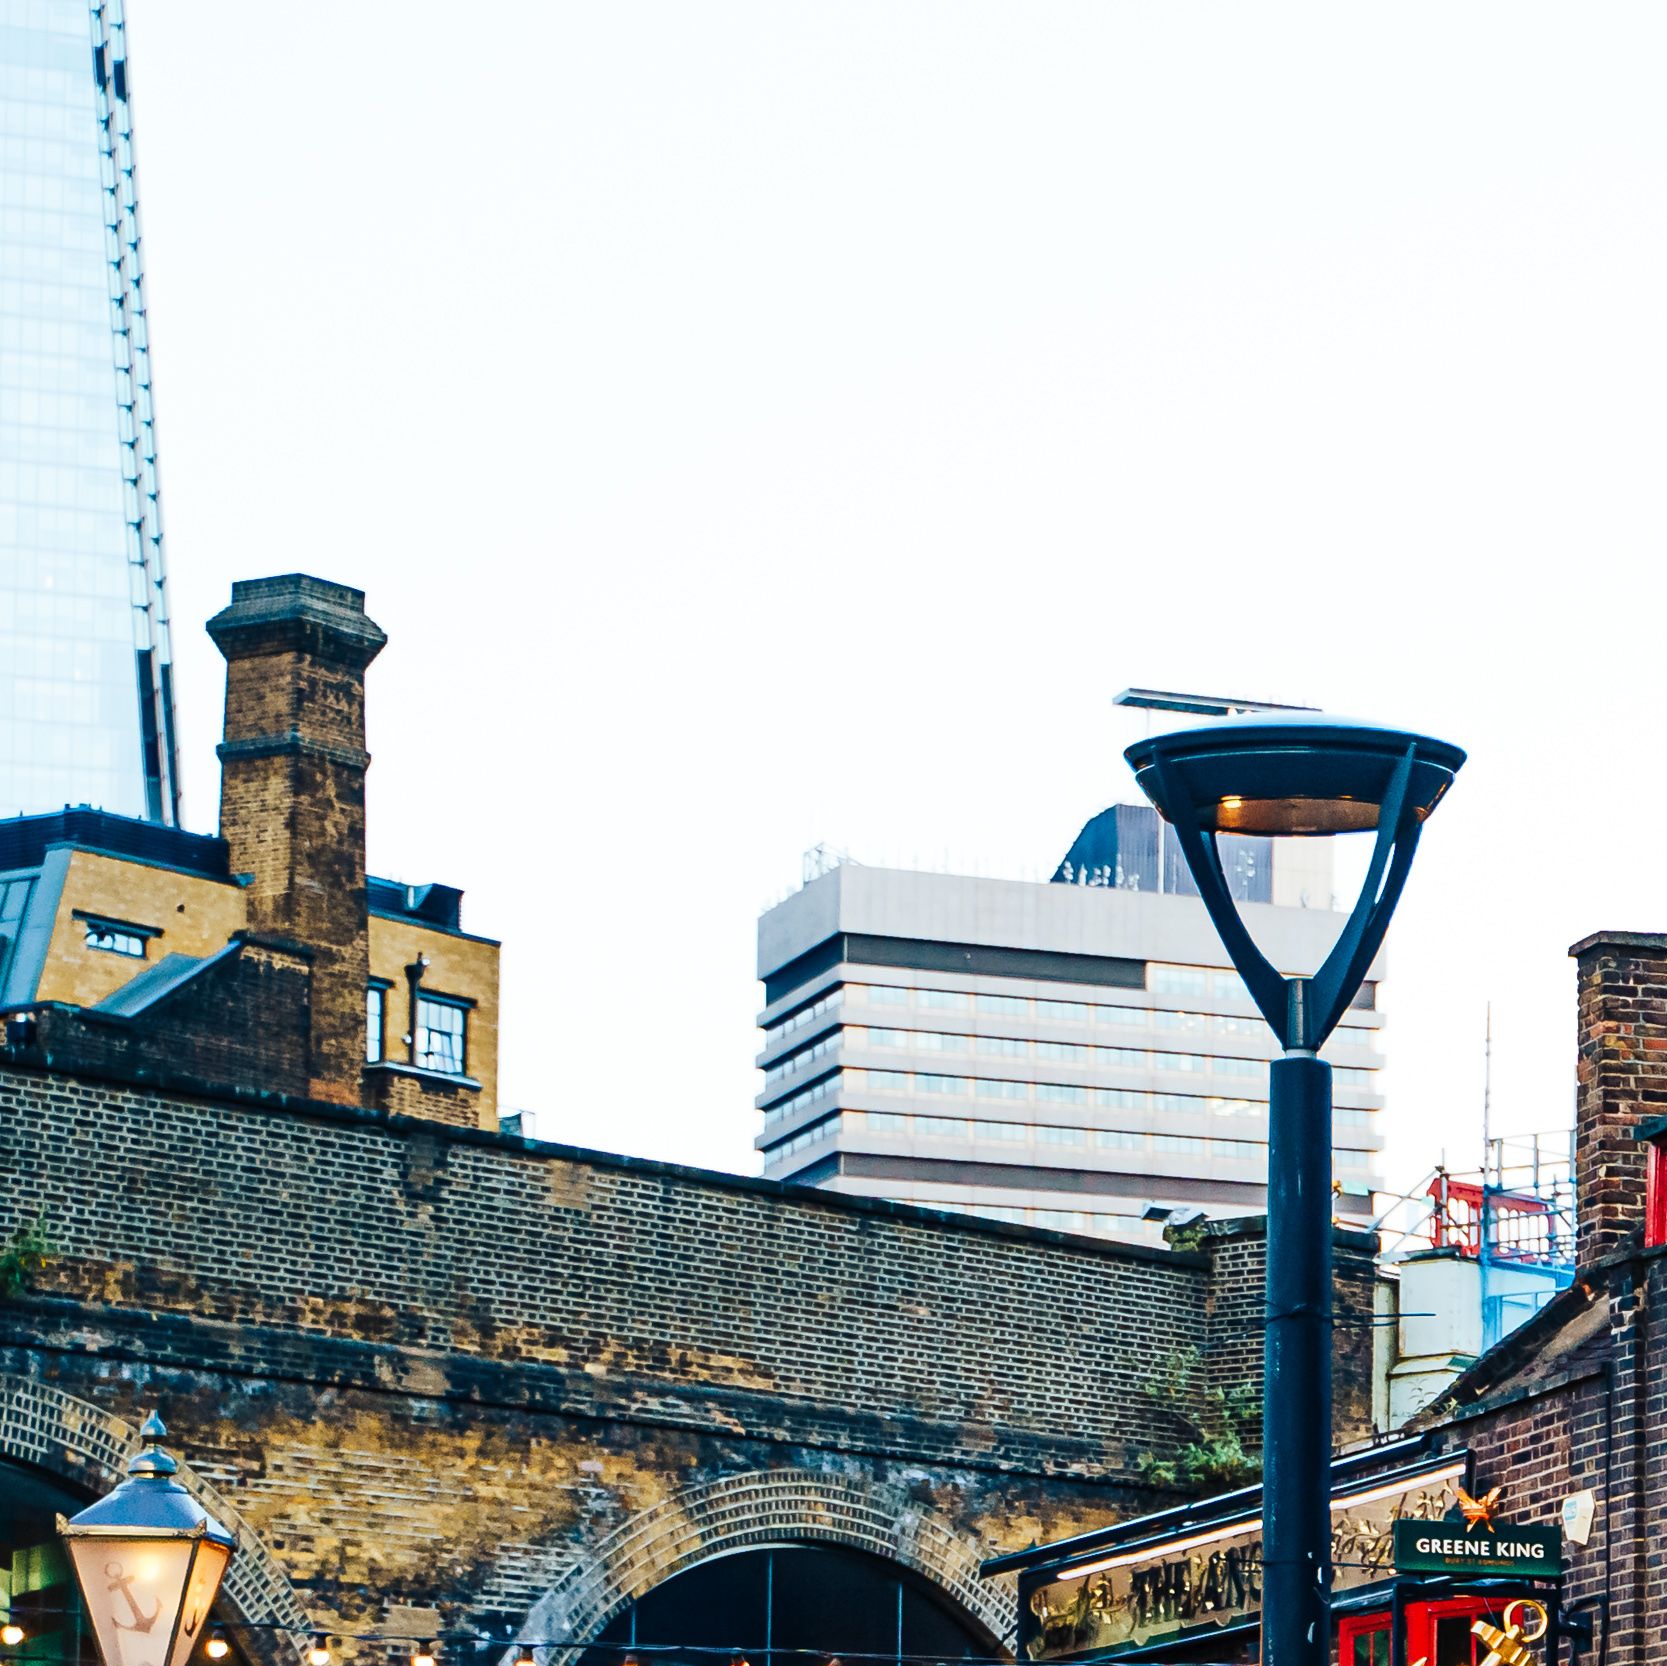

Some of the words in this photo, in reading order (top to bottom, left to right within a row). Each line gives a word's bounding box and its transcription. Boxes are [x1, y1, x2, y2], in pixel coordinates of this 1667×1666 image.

[1416, 1537, 1490, 1557] GREENE
[1496, 1541, 1545, 1559] KING
[1131, 1557, 1193, 1628] THE
[1200, 1540, 1263, 1614] ANC
